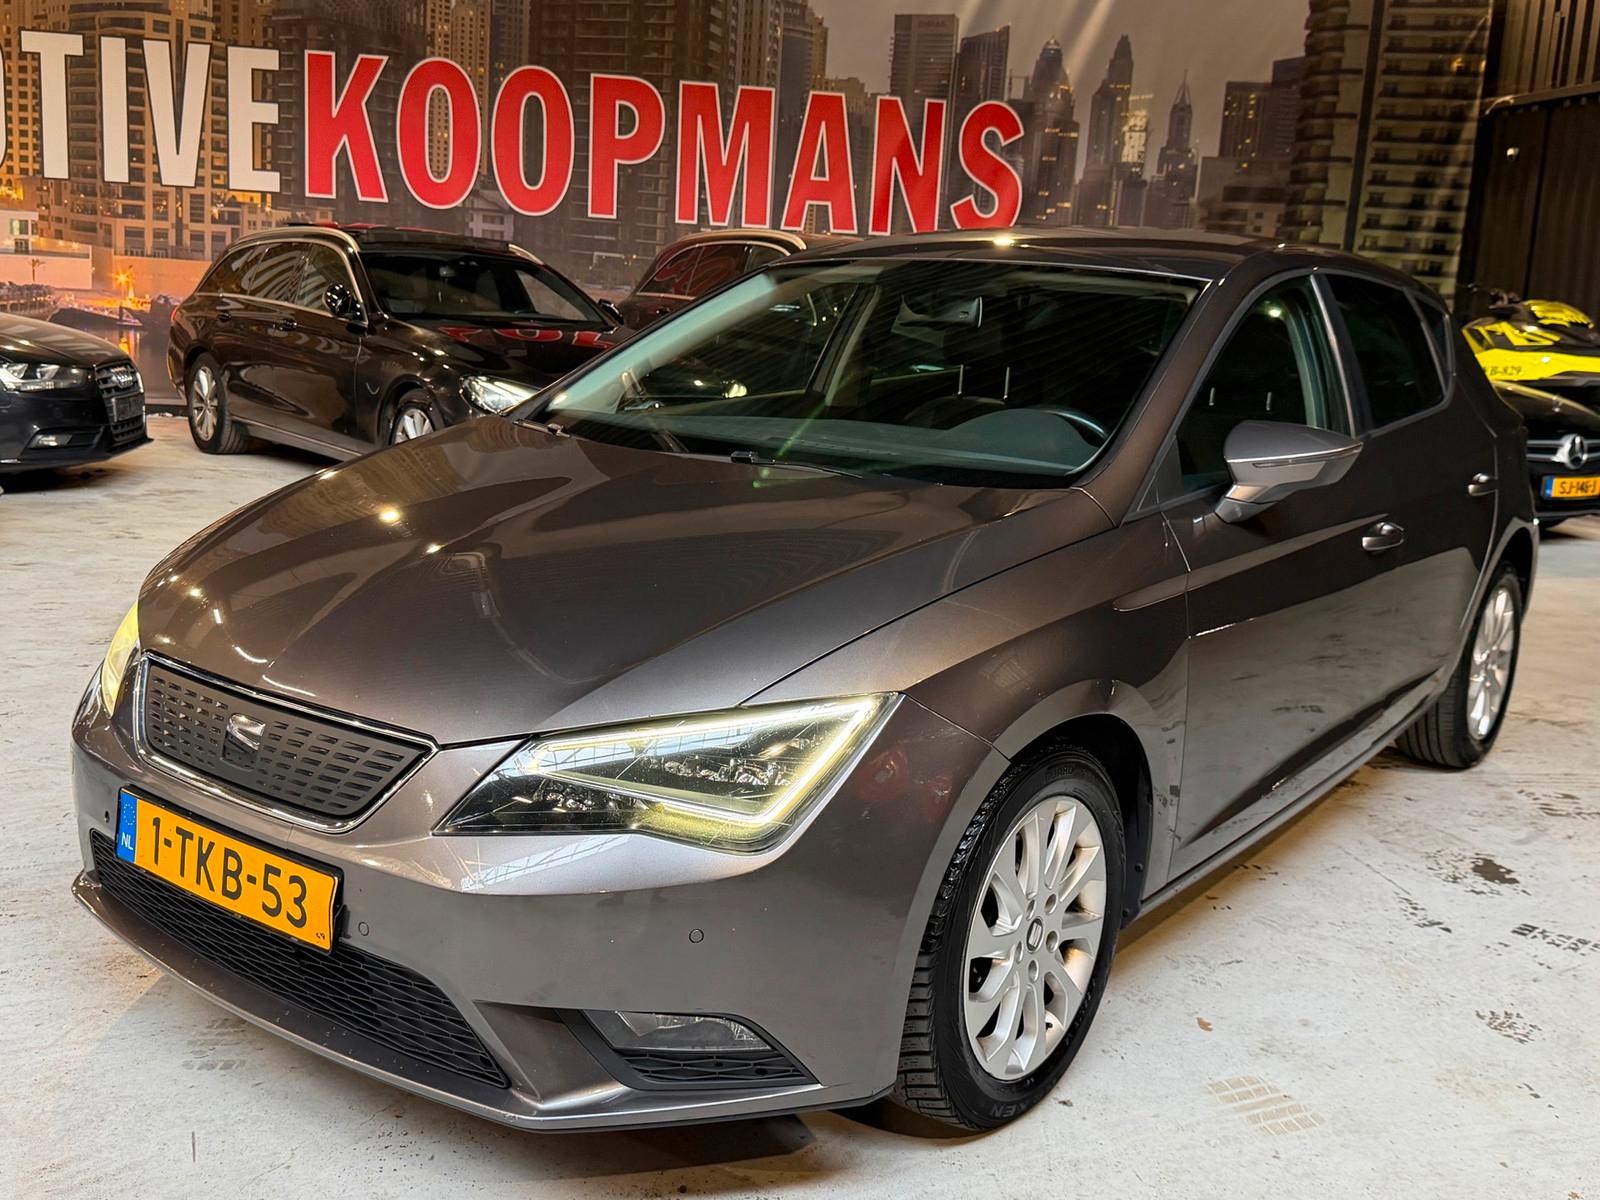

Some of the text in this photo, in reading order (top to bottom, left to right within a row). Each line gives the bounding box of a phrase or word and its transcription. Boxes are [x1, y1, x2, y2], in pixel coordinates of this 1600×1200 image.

[0, 30, 1025, 235] TIVE KOOPMANS
[121, 831, 134, 851] NL
[152, 816, 308, 929] 1-TKB-53
